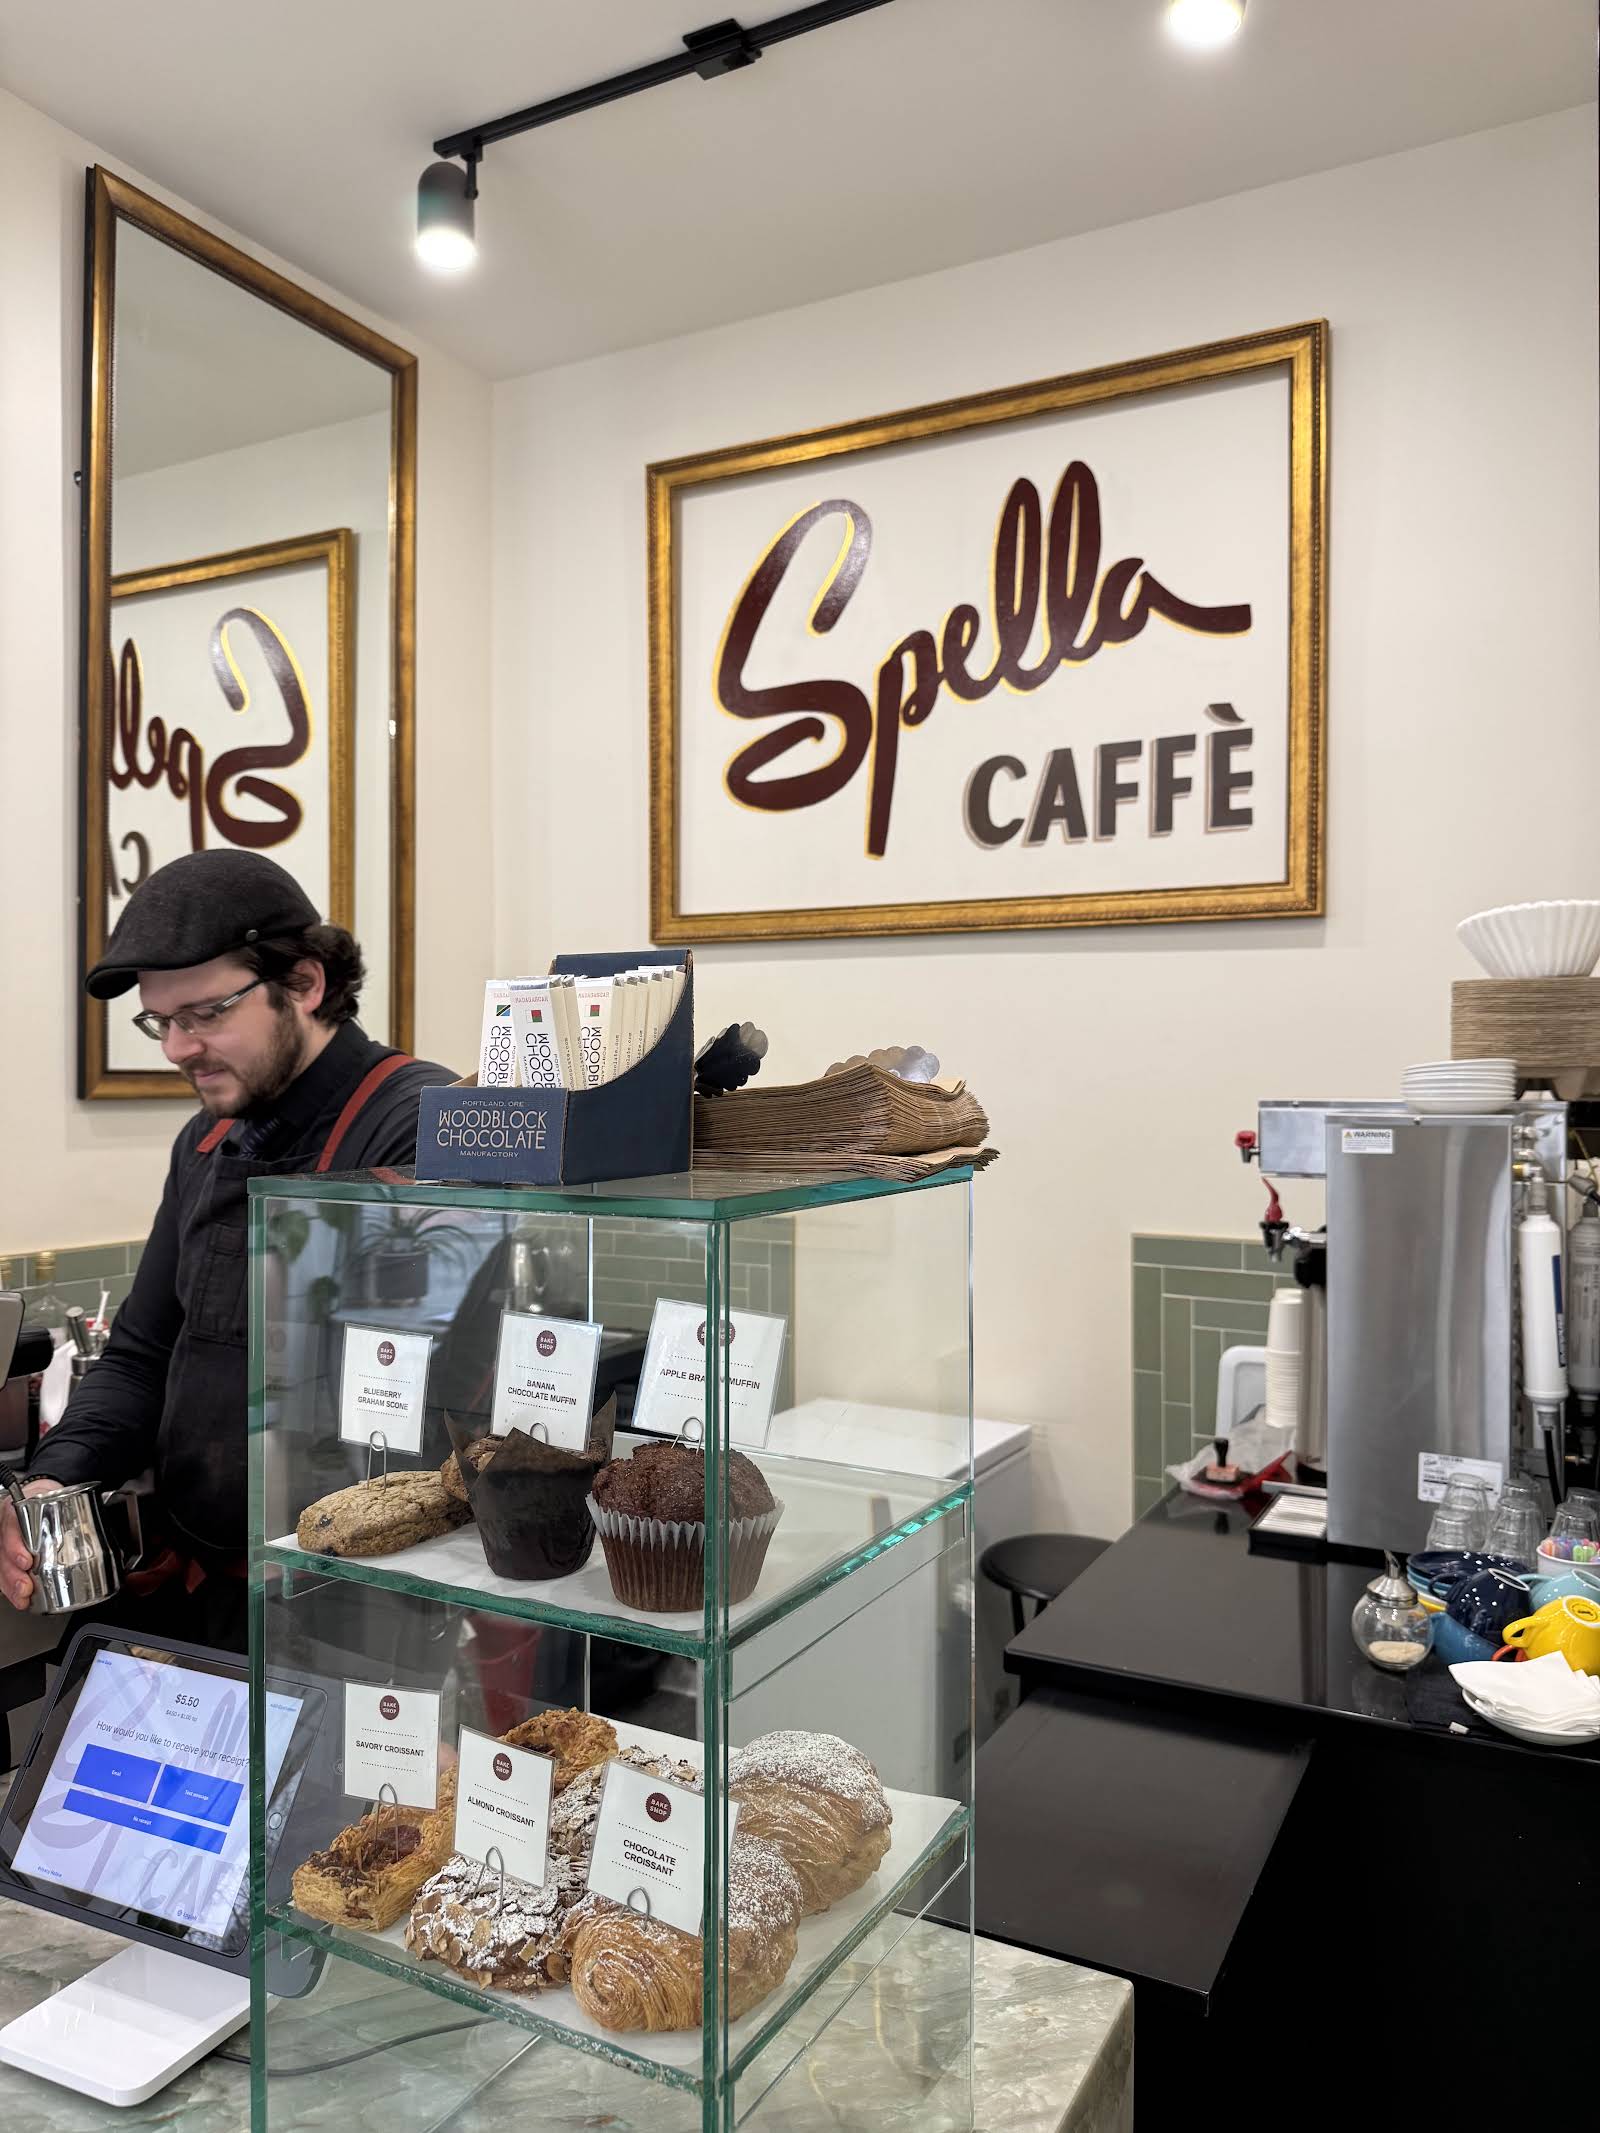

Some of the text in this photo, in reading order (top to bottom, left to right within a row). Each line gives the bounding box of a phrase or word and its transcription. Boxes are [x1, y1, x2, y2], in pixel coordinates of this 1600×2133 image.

[714, 460, 1252, 860] Spella
[962, 702, 1253, 850] CAFFÈ
[487, 1025, 501, 1088] CHOCO
[497, 1026, 513, 1088] WOODBL
[537, 1033, 556, 1088] WOODB
[438, 1109, 548, 1129] WOODBLOCK
[436, 1128, 546, 1150] CHOCOLATE
[460, 1150, 519, 1158] MANUFACTORY
[540, 1336, 554, 1344] BAKE
[659, 1368, 687, 1380] APPLE
[363, 1387, 402, 1399] BLUEBERRY
[527, 1379, 556, 1391] BANANA
[357, 1396, 409, 1411] GRAHAM SCONE
[507, 1387, 577, 1406] CHOCOLATE MUFFIN
[174, 1693, 199, 1708] $5.50
[382, 1701, 397, 1709] BAKE
[96, 1720, 250, 1768] How would you like to receive your receipt?
[355, 1740, 425, 1757] SAVORY CROISSANT
[495, 1765, 510, 1775] SHOP
[496, 1759, 510, 1769] BAKE
[467, 1796, 535, 1828] ALMOND CROISSANT
[649, 1805, 667, 1816] SHOP
[650, 1799, 668, 1810] BAKE
[623, 1839, 677, 1867] CHOCOLATE
[624, 1851, 675, 1877] CROISSANT
